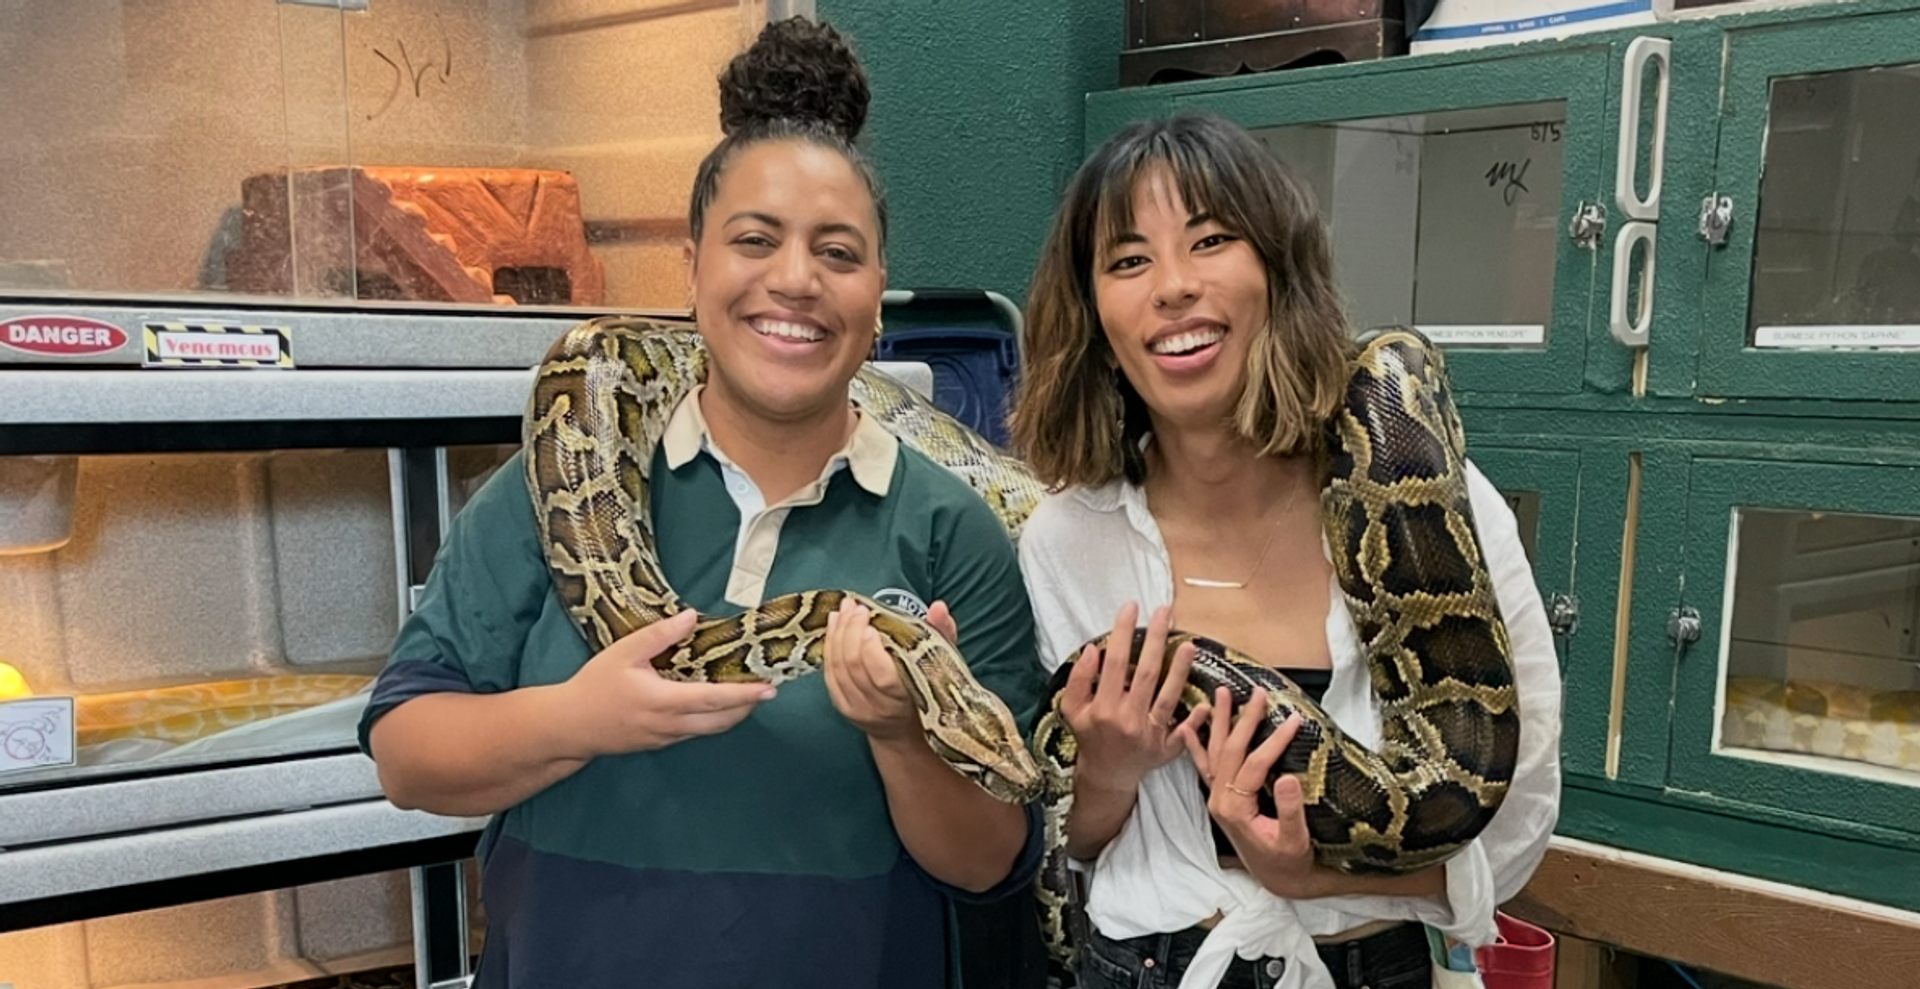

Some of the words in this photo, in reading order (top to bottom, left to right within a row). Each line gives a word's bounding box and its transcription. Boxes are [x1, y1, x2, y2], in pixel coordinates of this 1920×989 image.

[1547, 14, 1567, 25] CAPS
[8, 325, 113, 346] DANGER
[1455, 330, 1484, 338] PYTHON
[1773, 331, 1815, 340] BURMESE
[1818, 331, 1857, 340] PYTHON
[165, 338, 273, 357] Venomous
[899, 595, 927, 618] MOT
